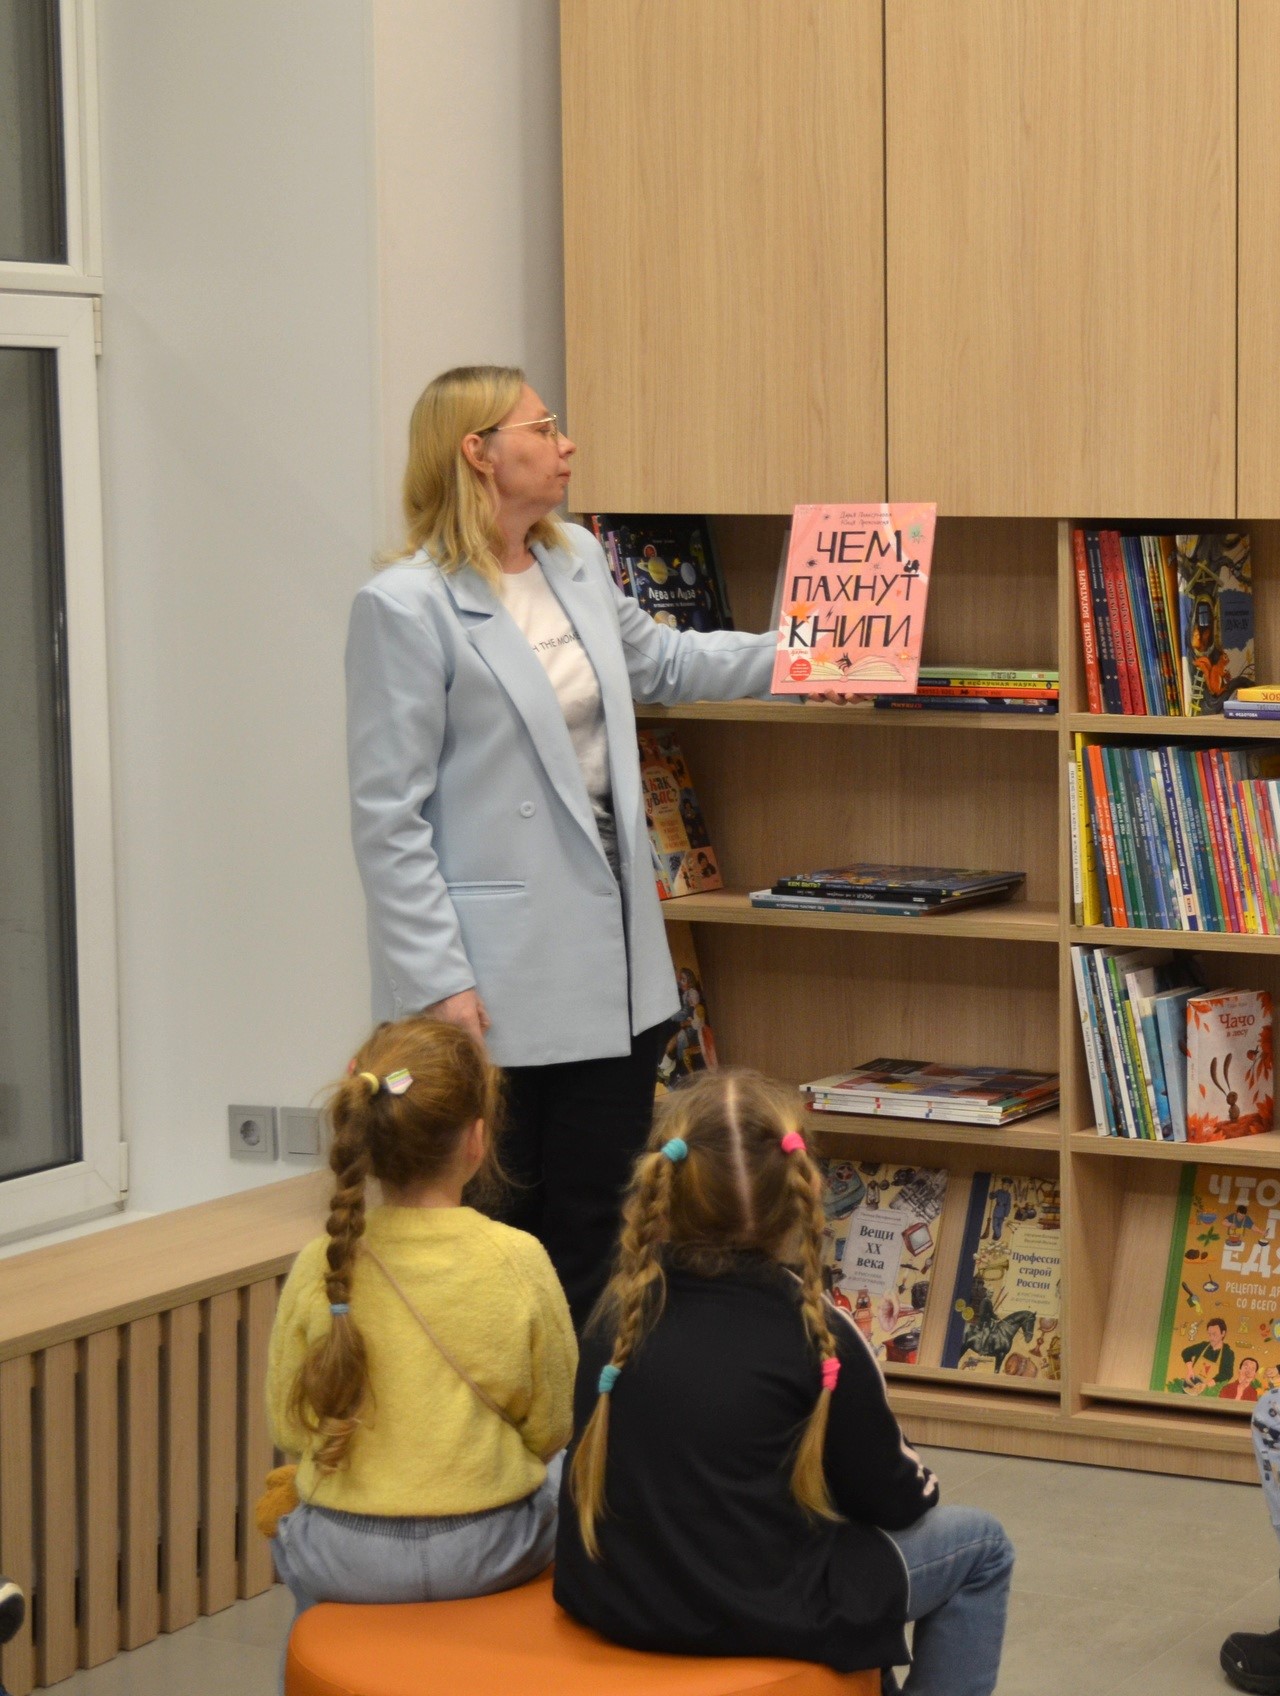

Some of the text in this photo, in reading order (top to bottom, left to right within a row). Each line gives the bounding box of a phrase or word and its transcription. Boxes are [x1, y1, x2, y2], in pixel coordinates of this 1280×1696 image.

[816, 530, 902, 563] ЧЕМ
[791, 573, 919, 606] ПАХНУТ
[1078, 569, 1093, 664] РУССКИЕ БОГАТЫРИ
[788, 614, 911, 648] КНИГИ
[539, 638, 556, 650] THE
[557, 632, 581, 647] MOME
[1219, 1013, 1255, 1030] Чачо
[859, 1225, 895, 1242] Вещи
[865, 1242, 882, 1255] XX
[857, 1257, 885, 1270] века
[1019, 1264, 1052, 1277] старой
[1016, 1278, 1051, 1290] России
[1225, 1282, 1267, 1298] РЕЦЕПТЫ
[1236, 1298, 1248, 1308] СО
[1250, 1299, 1277, 1311] ВСЕГО
